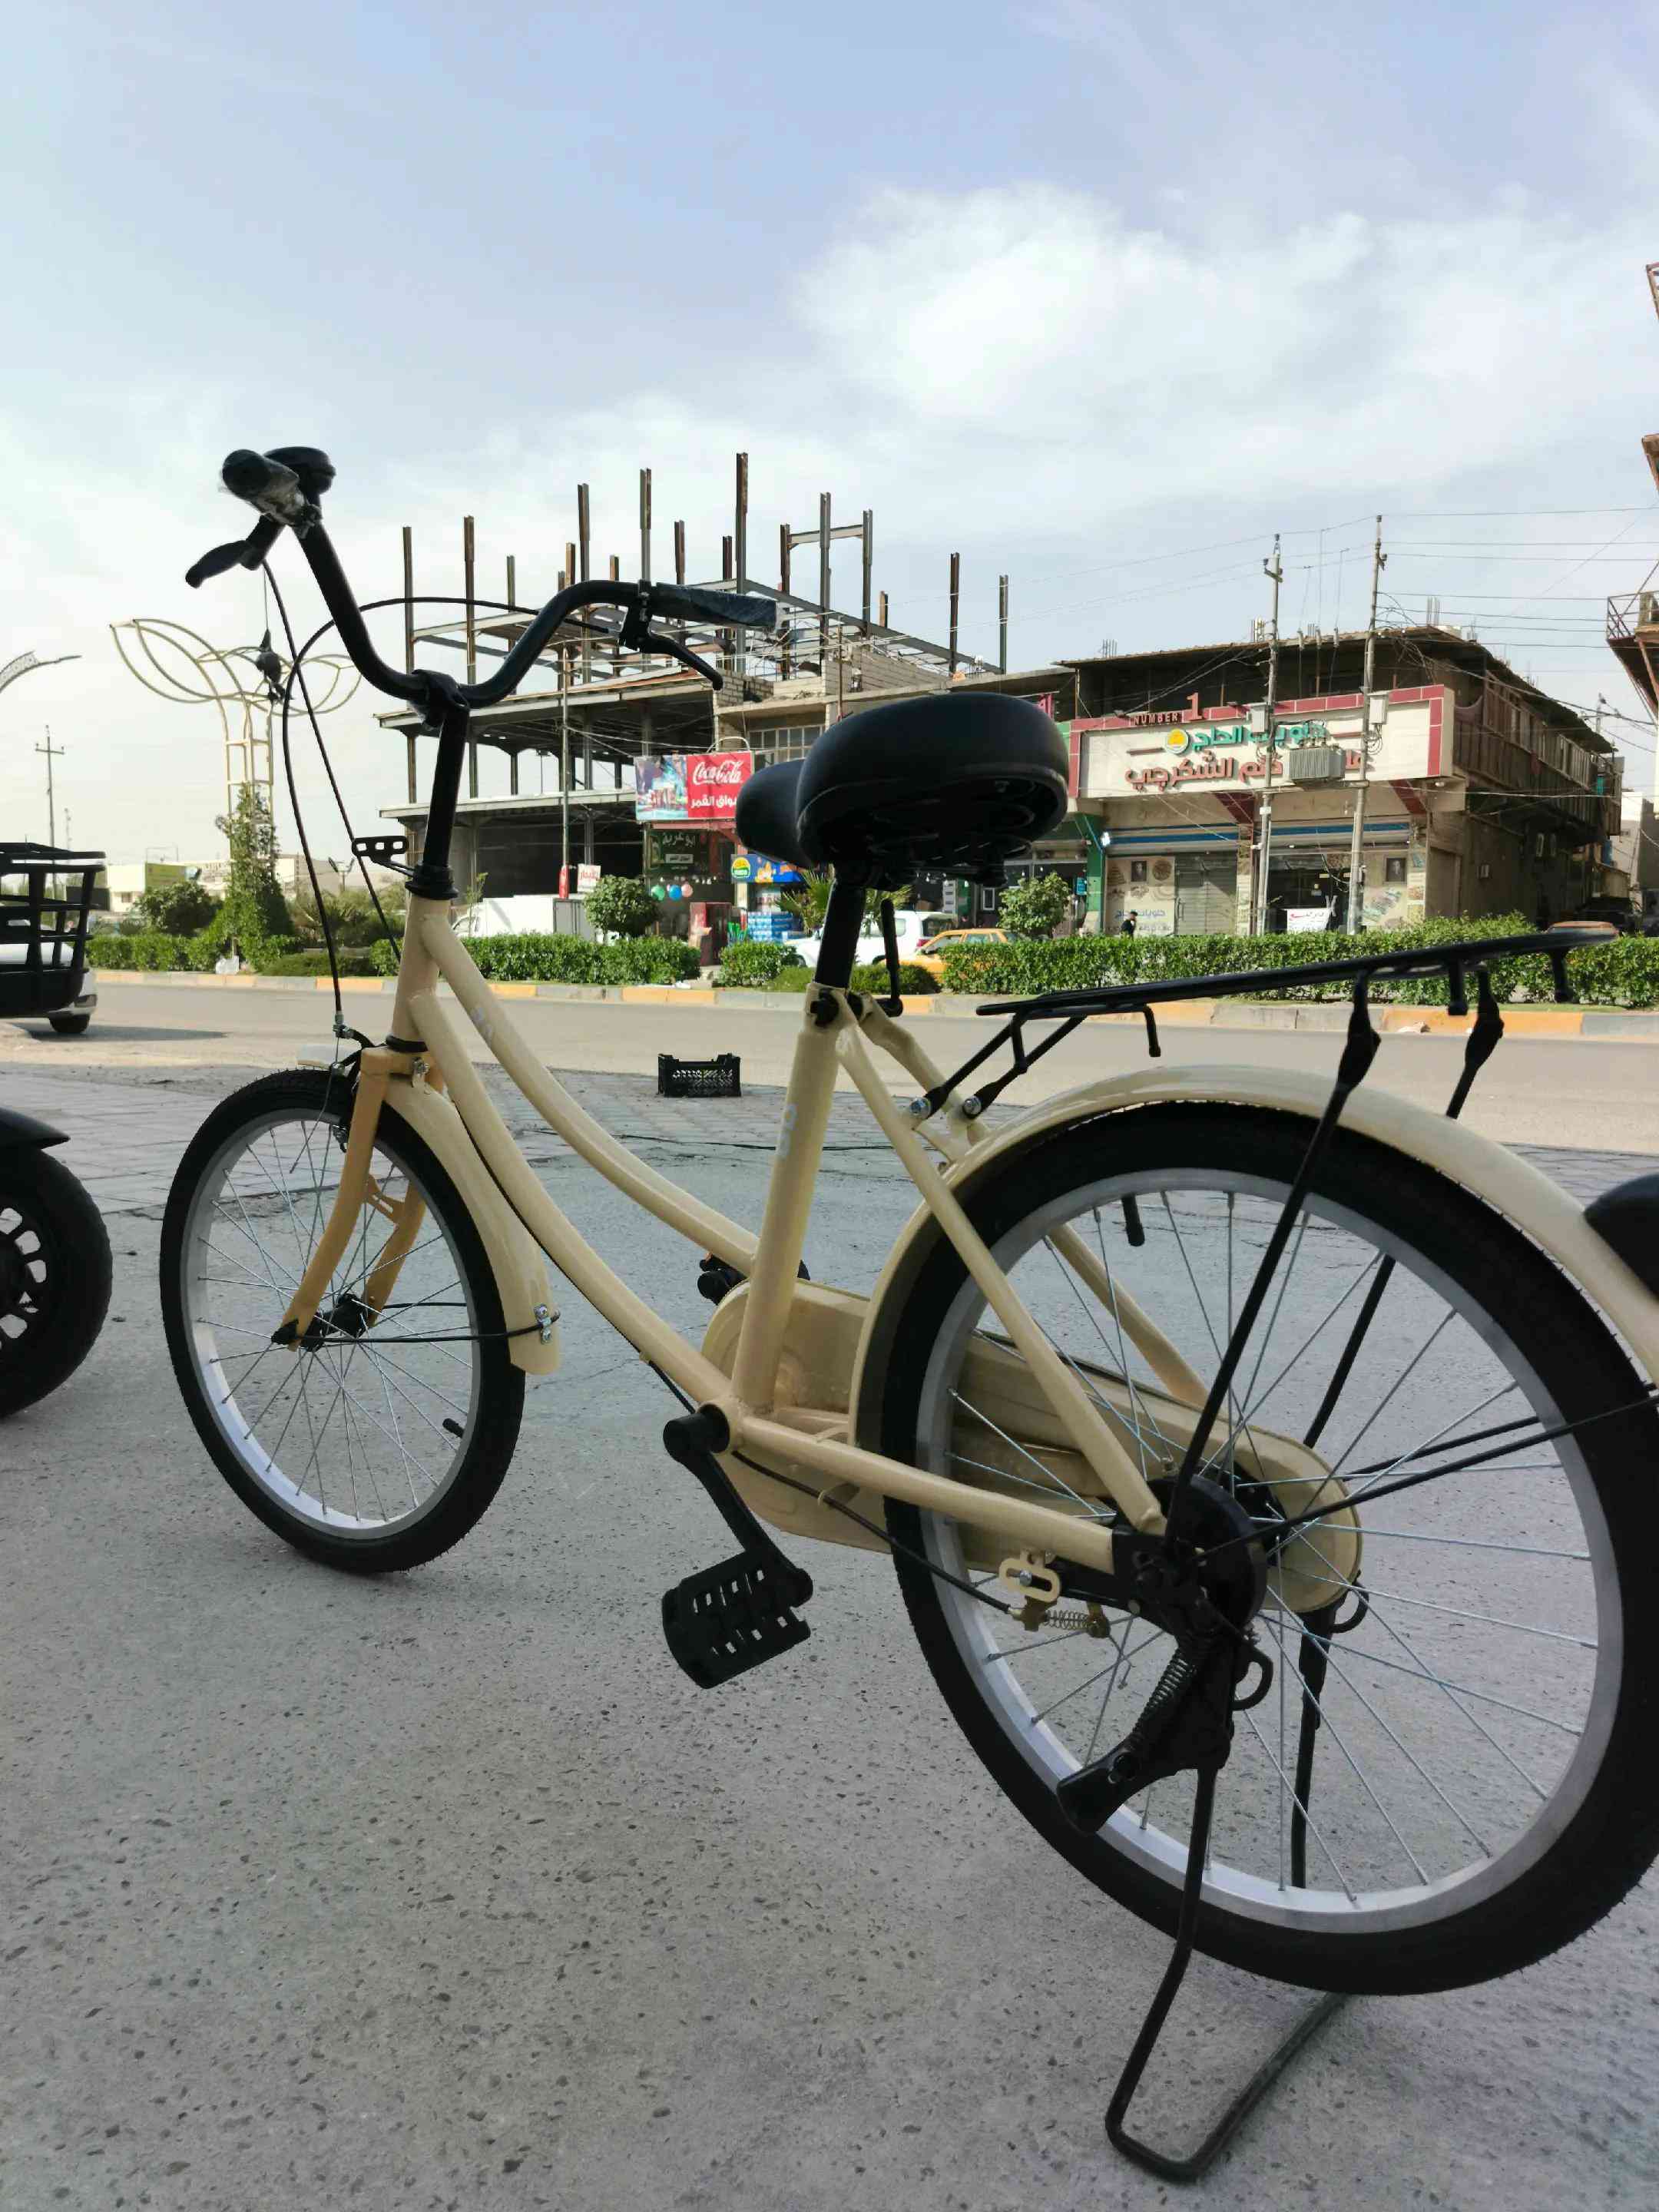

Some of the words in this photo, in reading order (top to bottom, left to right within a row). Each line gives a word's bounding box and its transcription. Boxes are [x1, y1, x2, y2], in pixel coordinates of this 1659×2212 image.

[1133, 712, 1181, 726] NUMBER
[1186, 691, 1204, 720] 1
[1191, 724, 1243, 753] الحاج
[1124, 749, 1234, 793] الشكرجي
[690, 793, 715, 809] القمر
